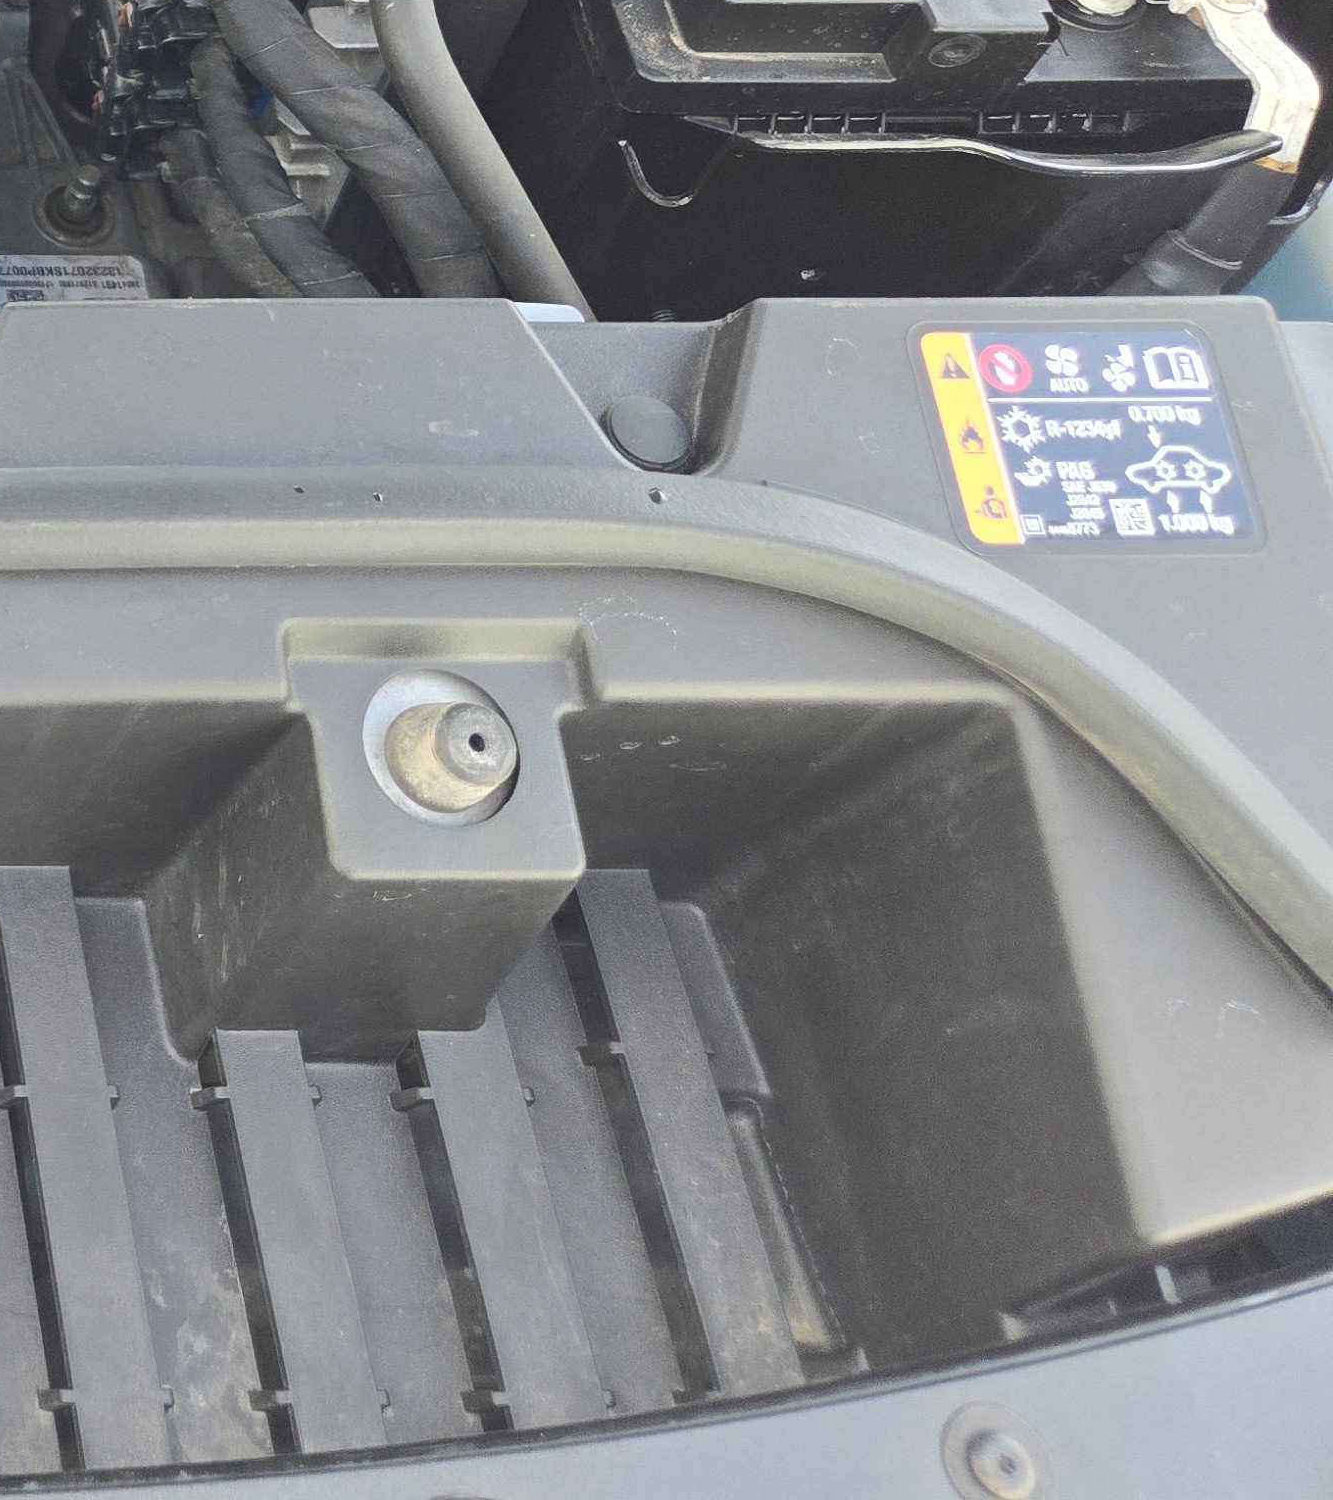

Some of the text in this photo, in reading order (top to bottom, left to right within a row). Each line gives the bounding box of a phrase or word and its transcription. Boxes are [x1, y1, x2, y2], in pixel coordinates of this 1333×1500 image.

[1049, 377, 1090, 393] AUTO
[1128, 405, 1176, 423] 0.700
[1044, 419, 1121, 441] R-1234yf
[1056, 461, 1096, 481] PAG
[1158, 513, 1209, 532] 1.000
